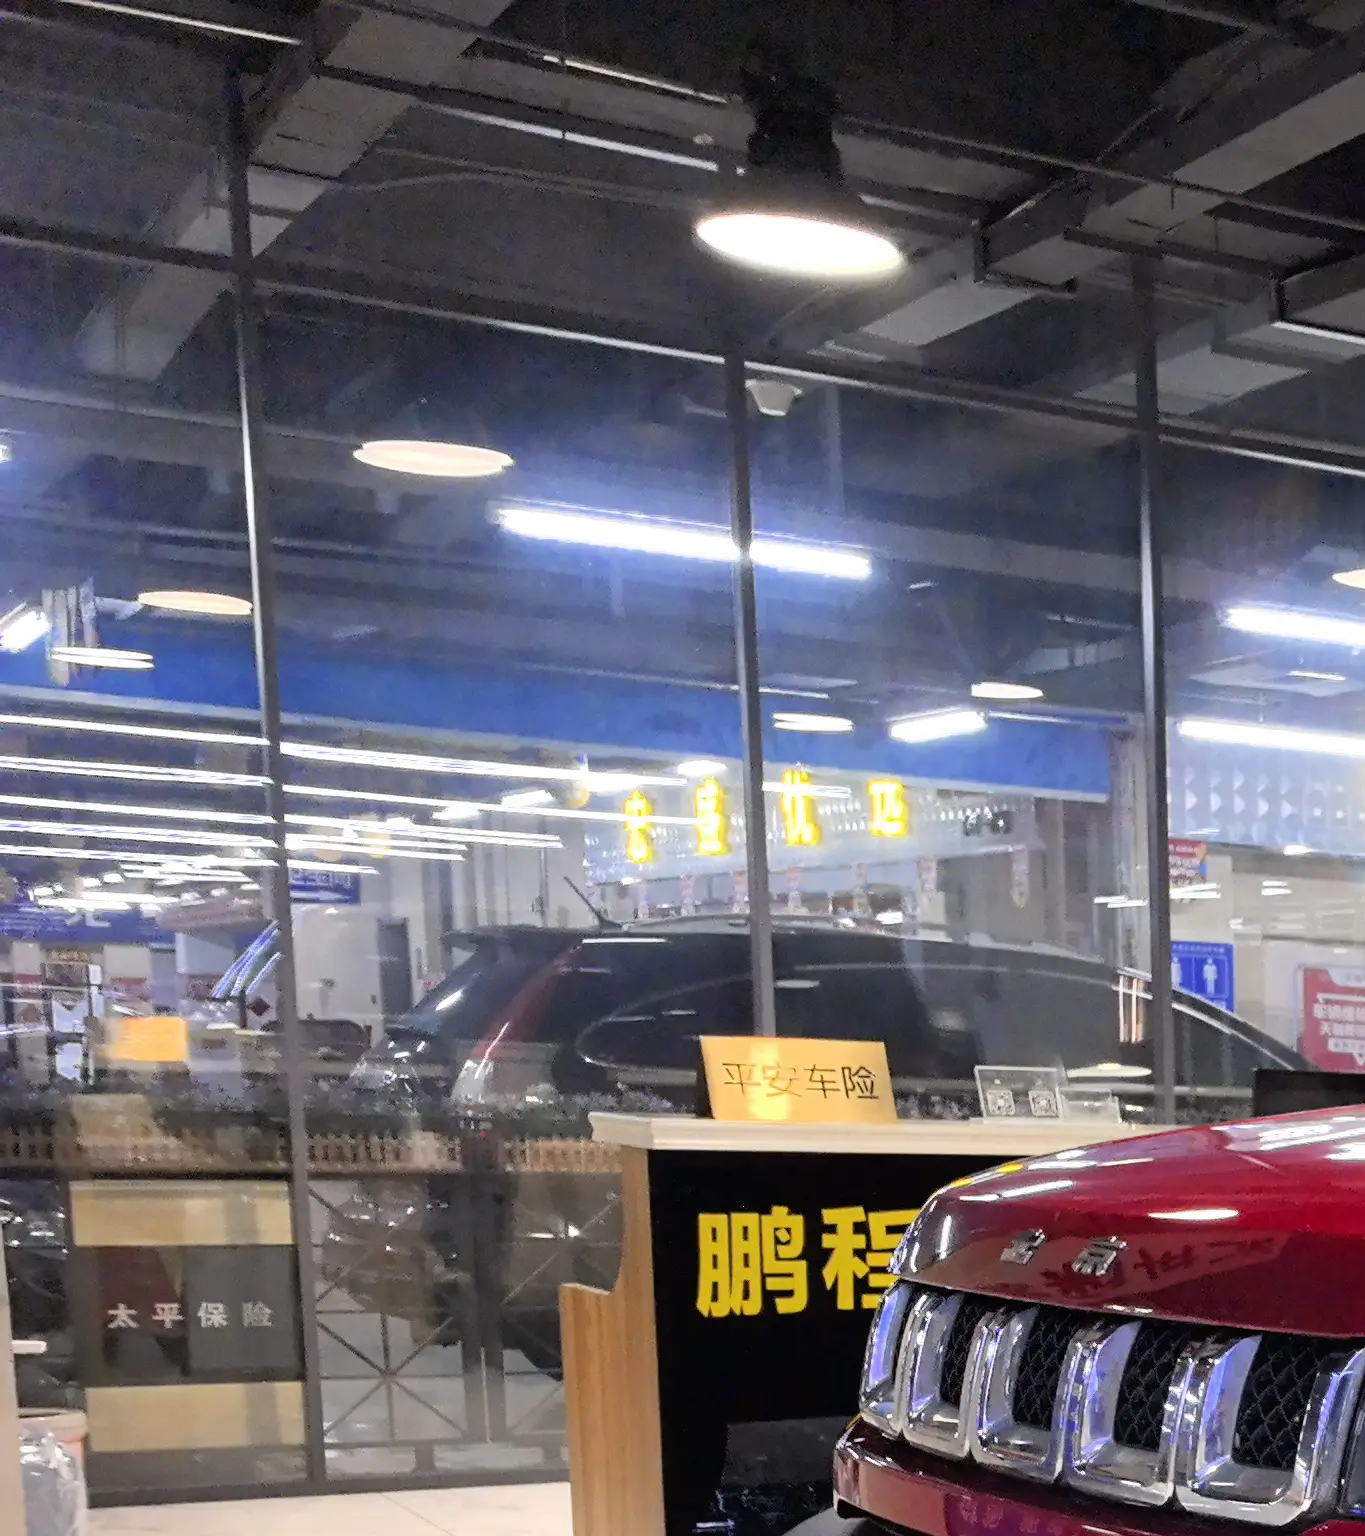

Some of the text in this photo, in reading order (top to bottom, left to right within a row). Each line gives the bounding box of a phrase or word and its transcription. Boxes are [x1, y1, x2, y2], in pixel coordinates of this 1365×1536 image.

[721, 1062, 879, 1099] 平安车险
[107, 1300, 275, 1329] 太平保险
